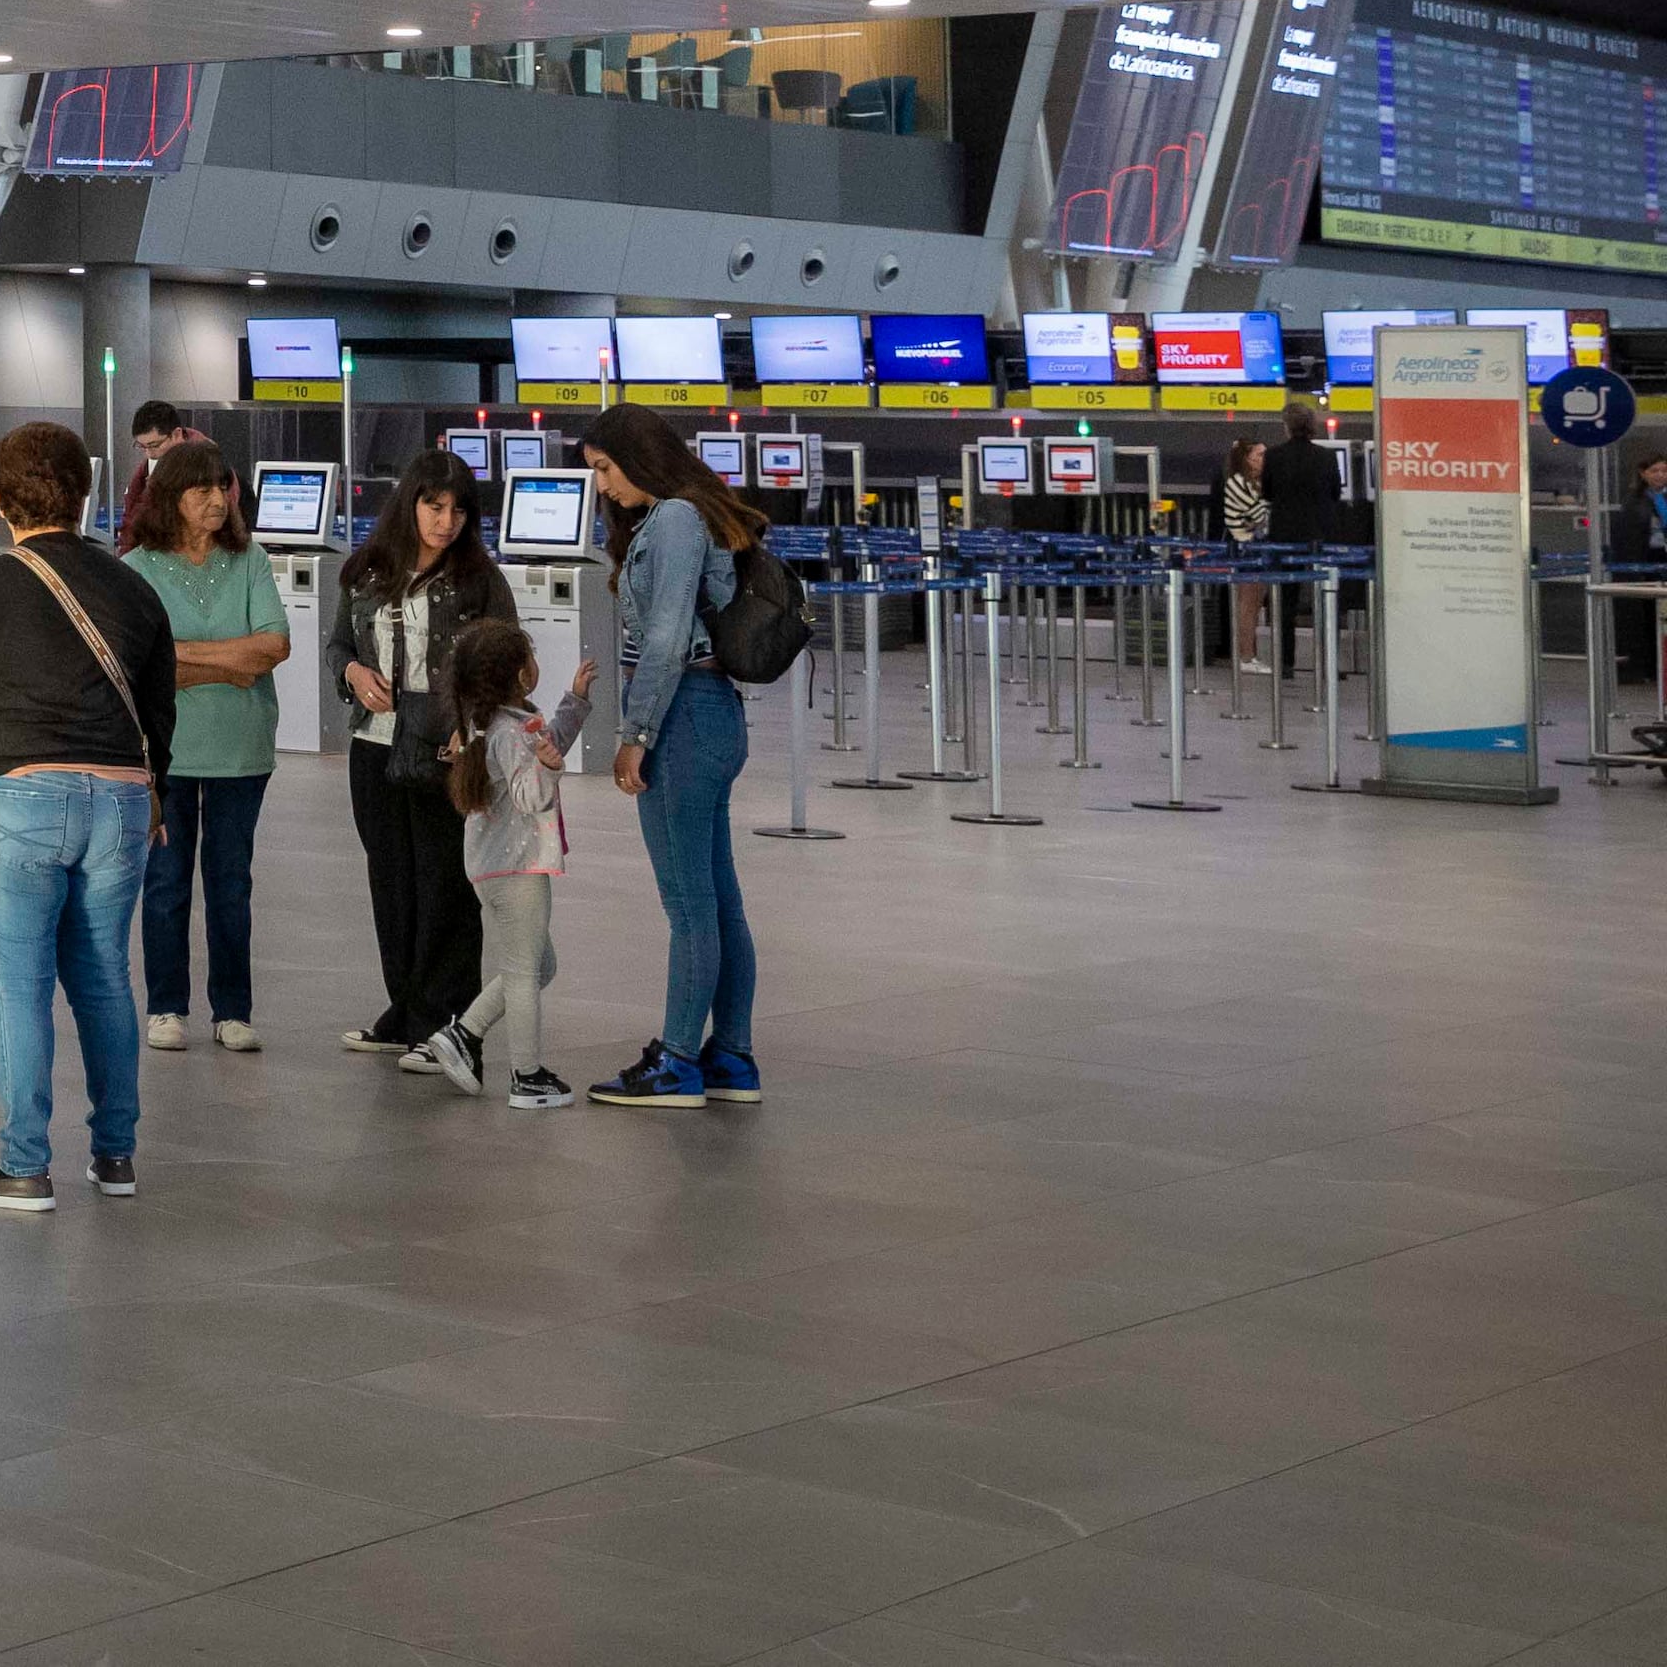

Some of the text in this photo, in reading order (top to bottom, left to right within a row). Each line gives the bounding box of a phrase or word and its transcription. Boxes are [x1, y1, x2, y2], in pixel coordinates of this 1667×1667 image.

[1160, 344, 1190, 355] SKY
[1161, 354, 1229, 366] PRIORITY
[1048, 361, 1089, 374] Economy
[1393, 370, 1477, 385] Argentinas
[287, 386, 308, 398] F10
[555, 386, 579, 401] F09
[663, 388, 688, 401] F08
[802, 389, 827, 403] F07
[923, 390, 949, 404] F06
[1077, 390, 1105, 404] F05
[1209, 391, 1238, 405] F04
[1386, 441, 1439, 458] SKY
[1386, 460, 1511, 479] PRIORITY
